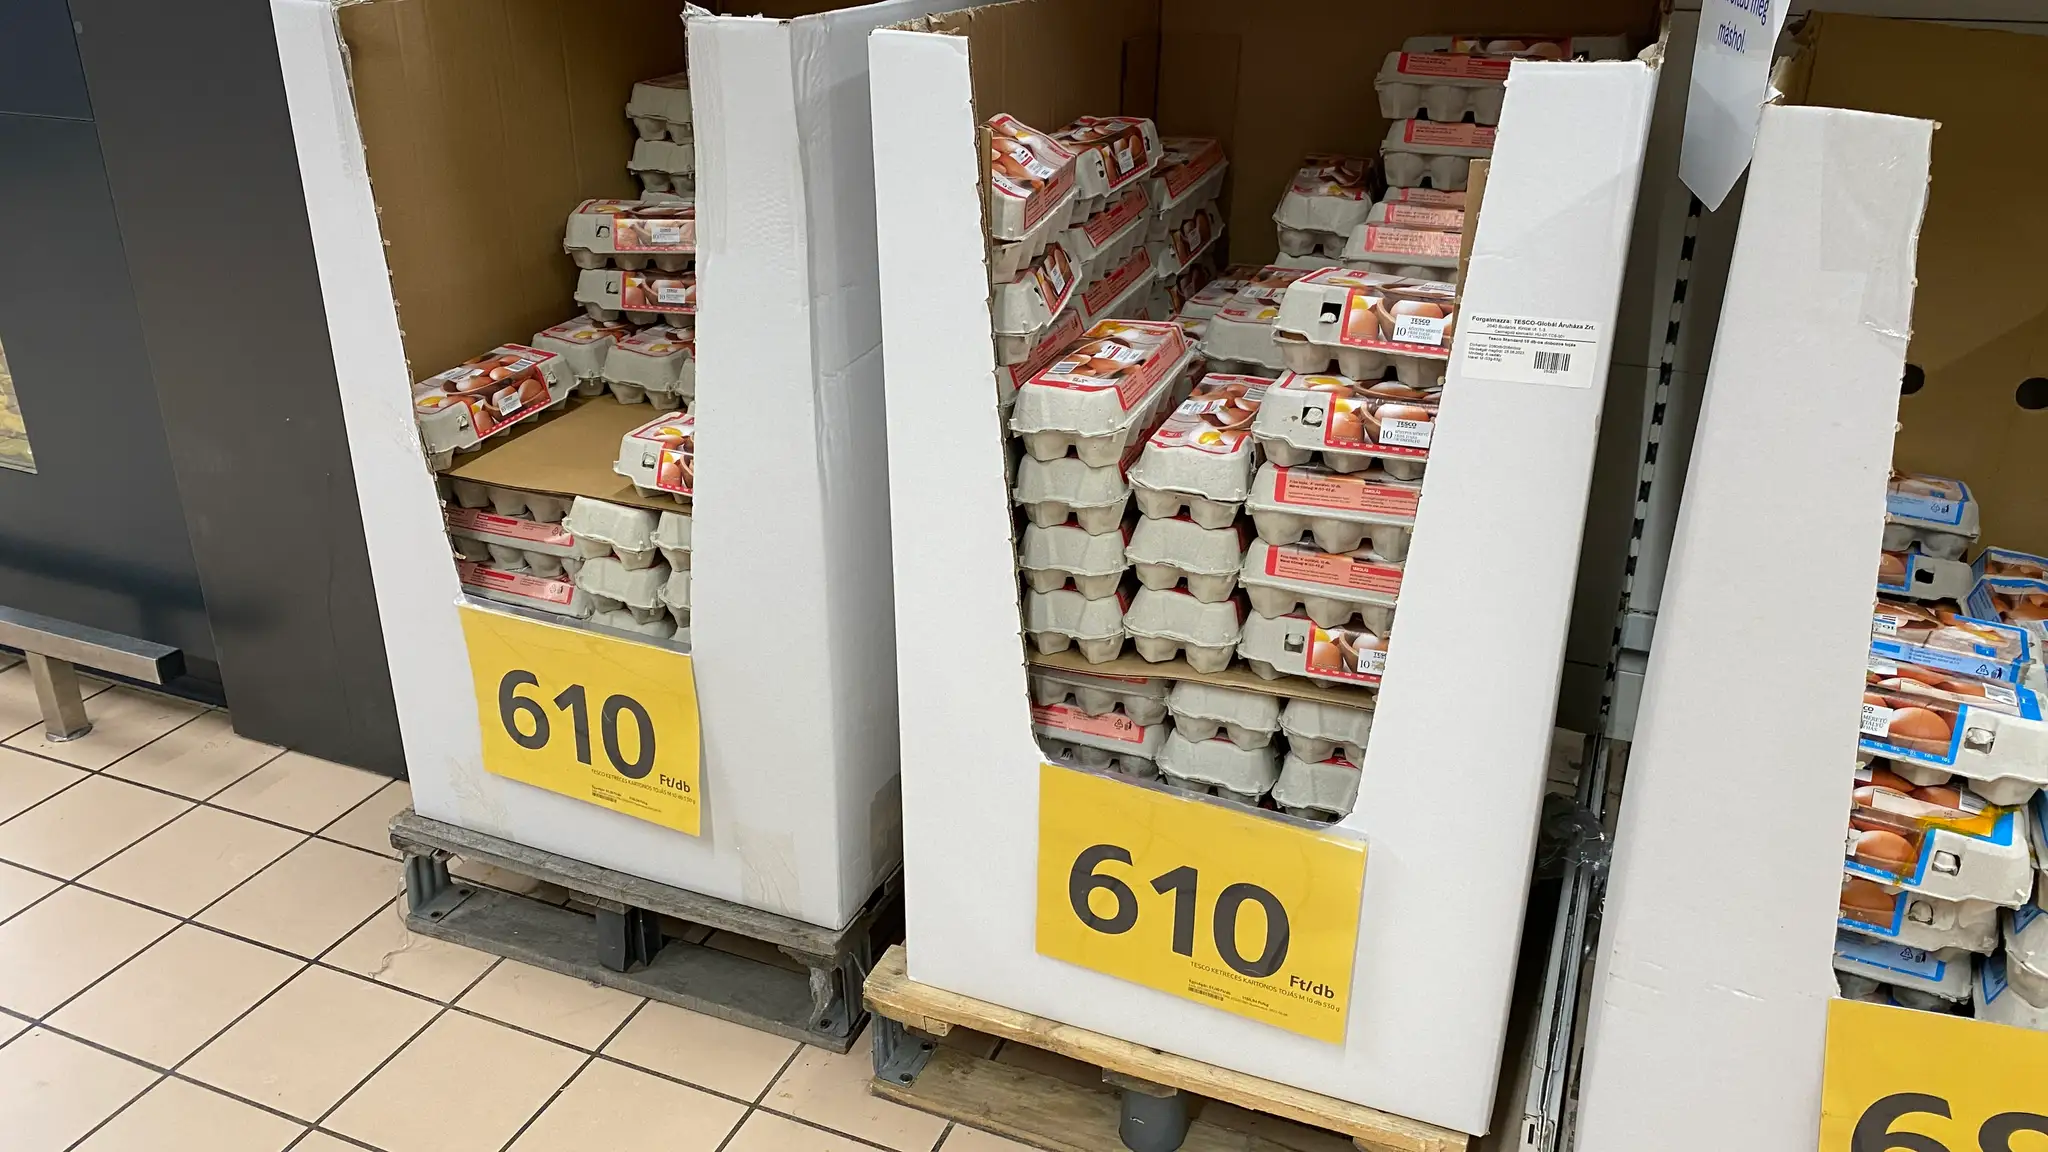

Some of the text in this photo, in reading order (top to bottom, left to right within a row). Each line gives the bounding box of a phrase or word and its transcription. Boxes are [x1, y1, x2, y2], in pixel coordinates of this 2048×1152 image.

[1717, 20, 1747, 54] máshol.
[1471, 315, 1512, 324] Forgalmazza:
[1514, 318, 1558, 327] TESCO-Globál
[1558, 321, 1584, 329] Áruháza
[1396, 326, 1407, 336] 10
[1396, 420, 1417, 428] TESCO
[1382, 430, 1393, 439] 10
[1359, 660, 1370, 668] 10
[499, 670, 691, 793] 610 Ft/db
[1068, 843, 1335, 999] 610 Ft/db
[1190, 961, 1210, 972] TESCO
[1210, 966, 1242, 982] KETRECES
[1242, 978, 1278, 993] KARTONOS
[1278, 987, 1298, 999] TOJÁS
